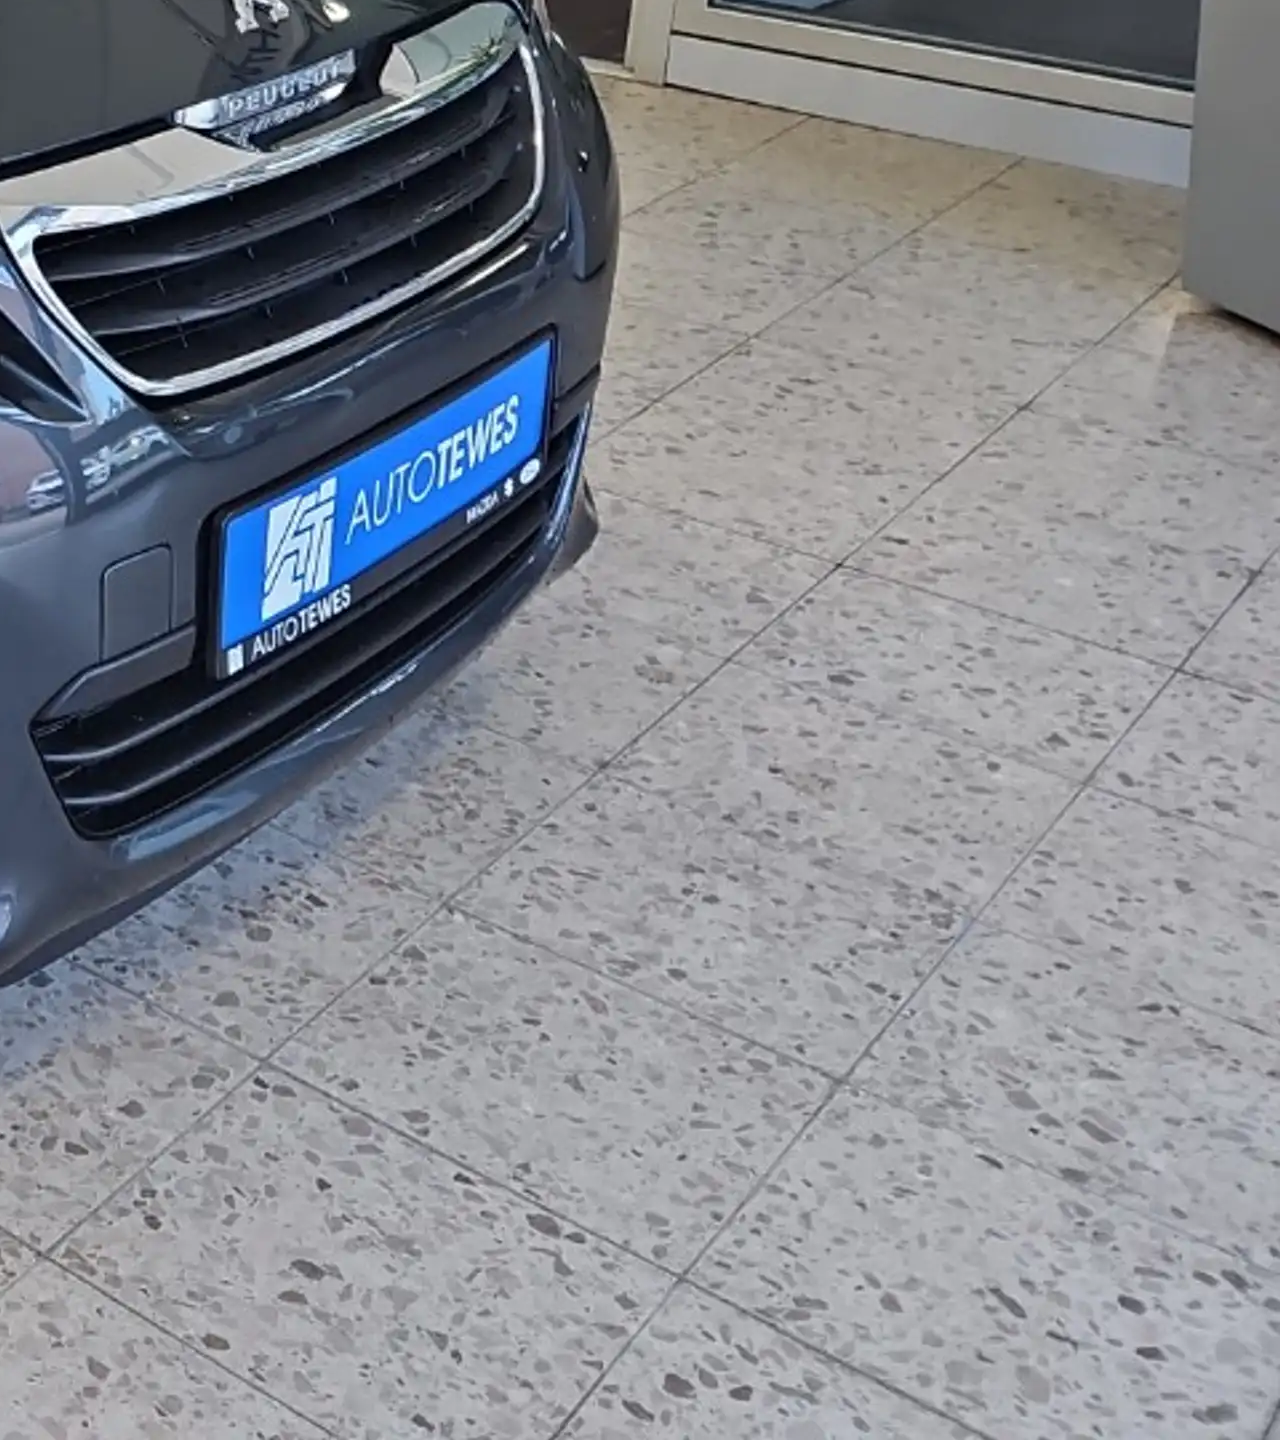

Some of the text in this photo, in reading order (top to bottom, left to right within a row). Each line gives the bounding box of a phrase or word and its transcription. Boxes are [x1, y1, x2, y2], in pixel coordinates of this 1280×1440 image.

[226, 62, 340, 119] PEUGEOT
[345, 394, 520, 546] AUTOTEWES
[251, 583, 352, 662] AUTOTEWES
